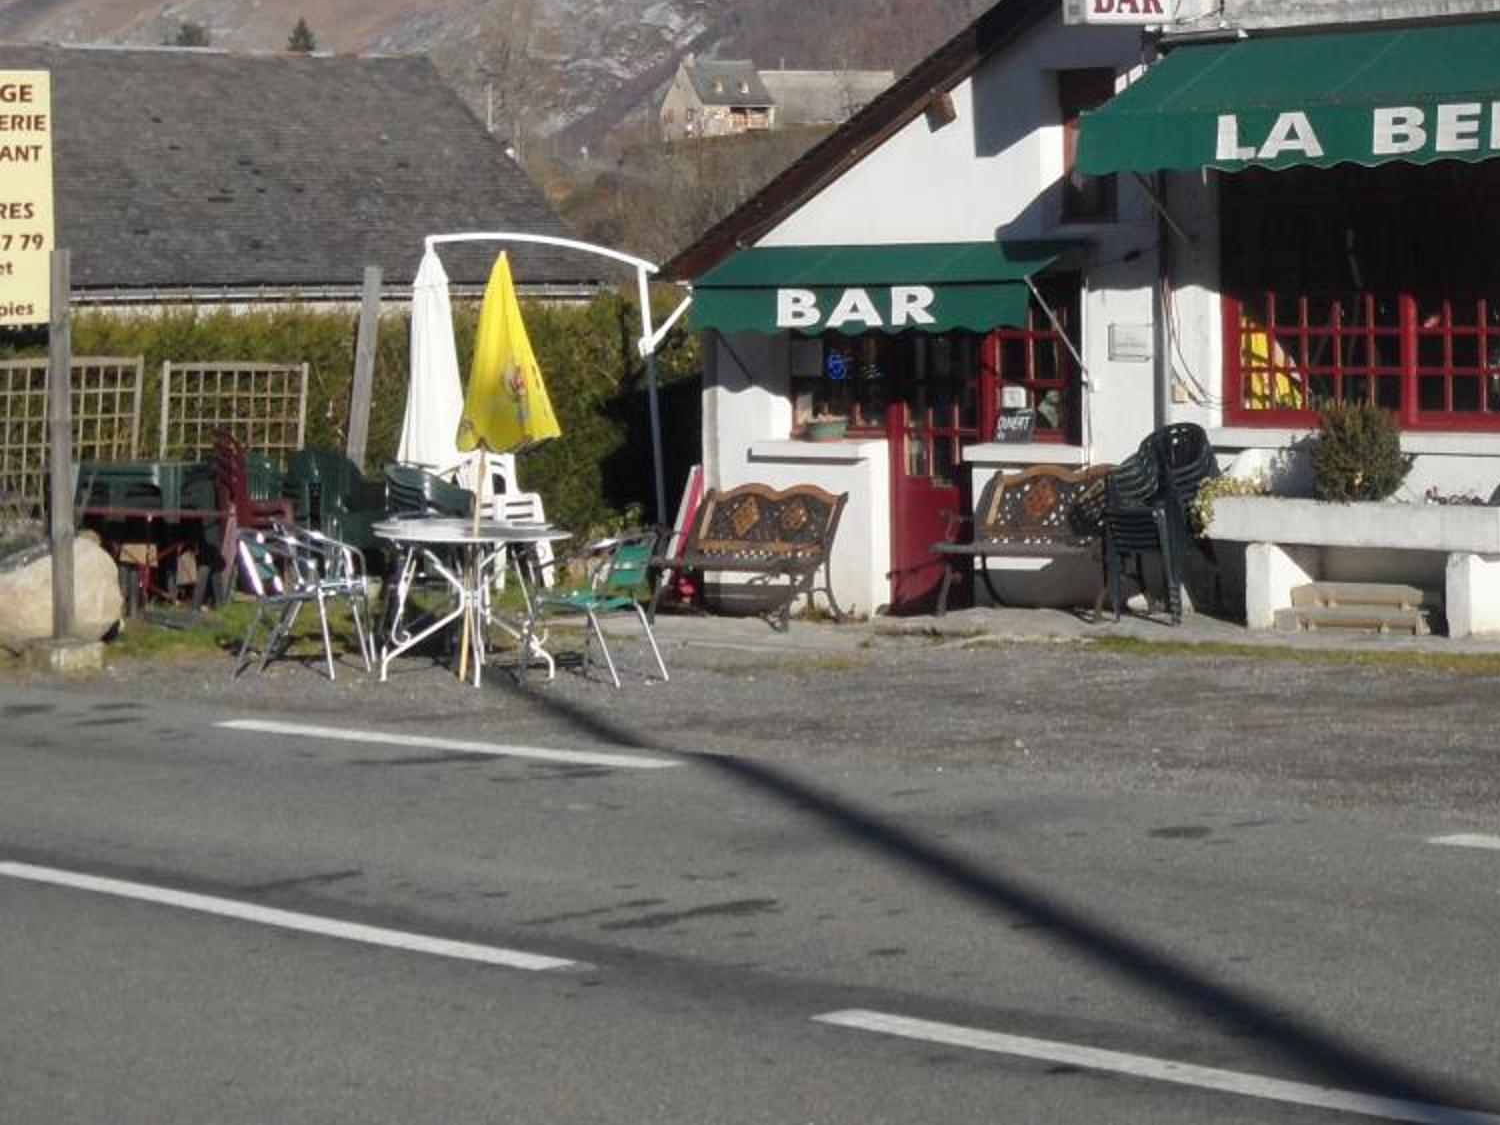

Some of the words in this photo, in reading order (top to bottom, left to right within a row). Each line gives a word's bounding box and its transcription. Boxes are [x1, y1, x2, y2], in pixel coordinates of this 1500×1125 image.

[1215, 111, 1324, 160] LA
[20, 232, 45, 252] 79
[776, 285, 936, 327] BAR
